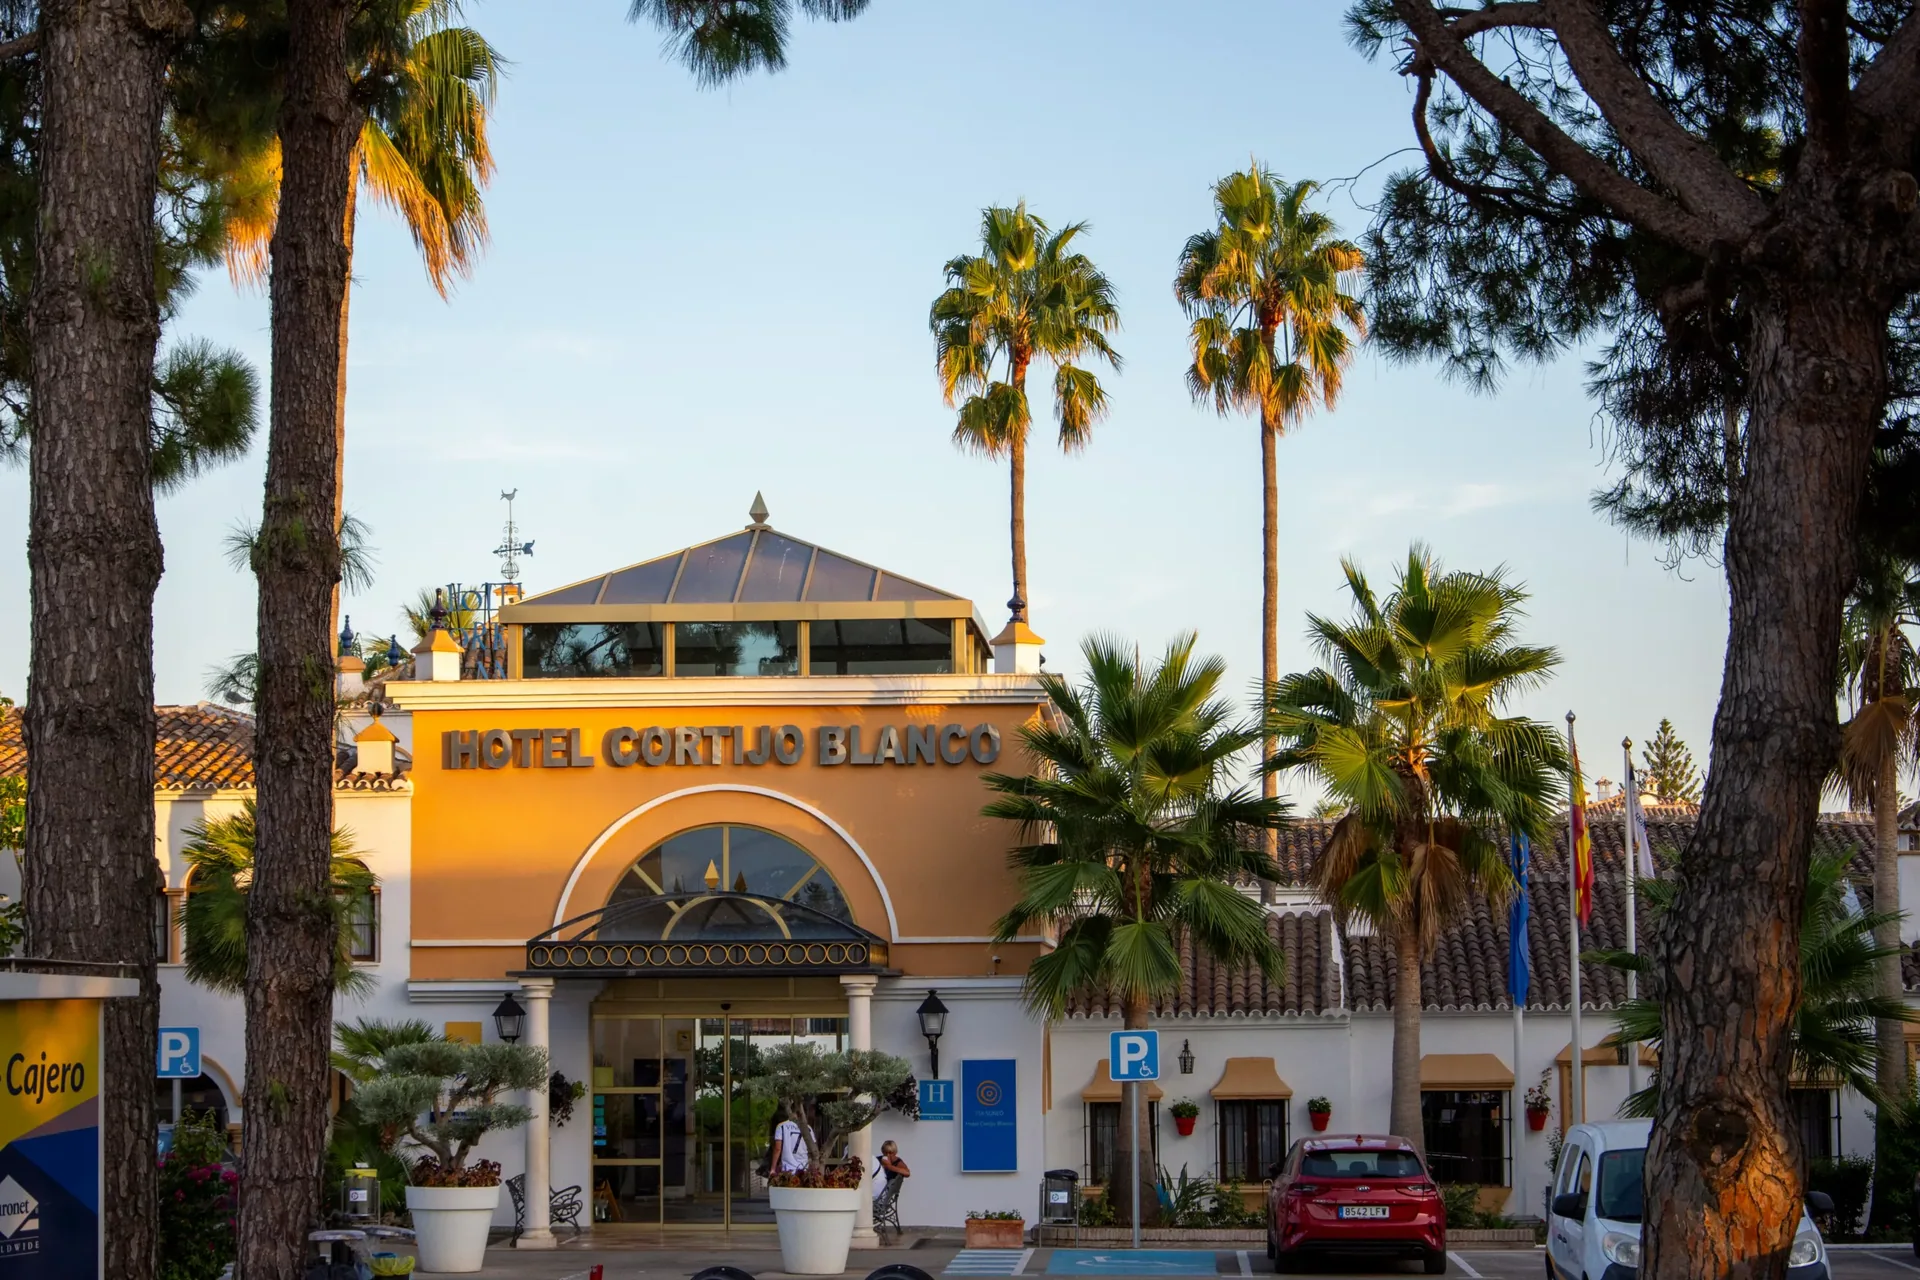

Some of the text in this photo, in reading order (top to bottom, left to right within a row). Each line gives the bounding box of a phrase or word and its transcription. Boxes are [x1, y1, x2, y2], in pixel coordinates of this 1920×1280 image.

[443, 723, 1000, 769] HOTEL CORTIJO BLANCO
[161, 1032, 190, 1071] P
[1120, 1036, 1148, 1074] P
[6, 1051, 85, 1104] Cajero
[927, 1083, 947, 1102] H
[790, 1131, 802, 1154] 7
[1345, 1207, 1367, 1216] 8542
